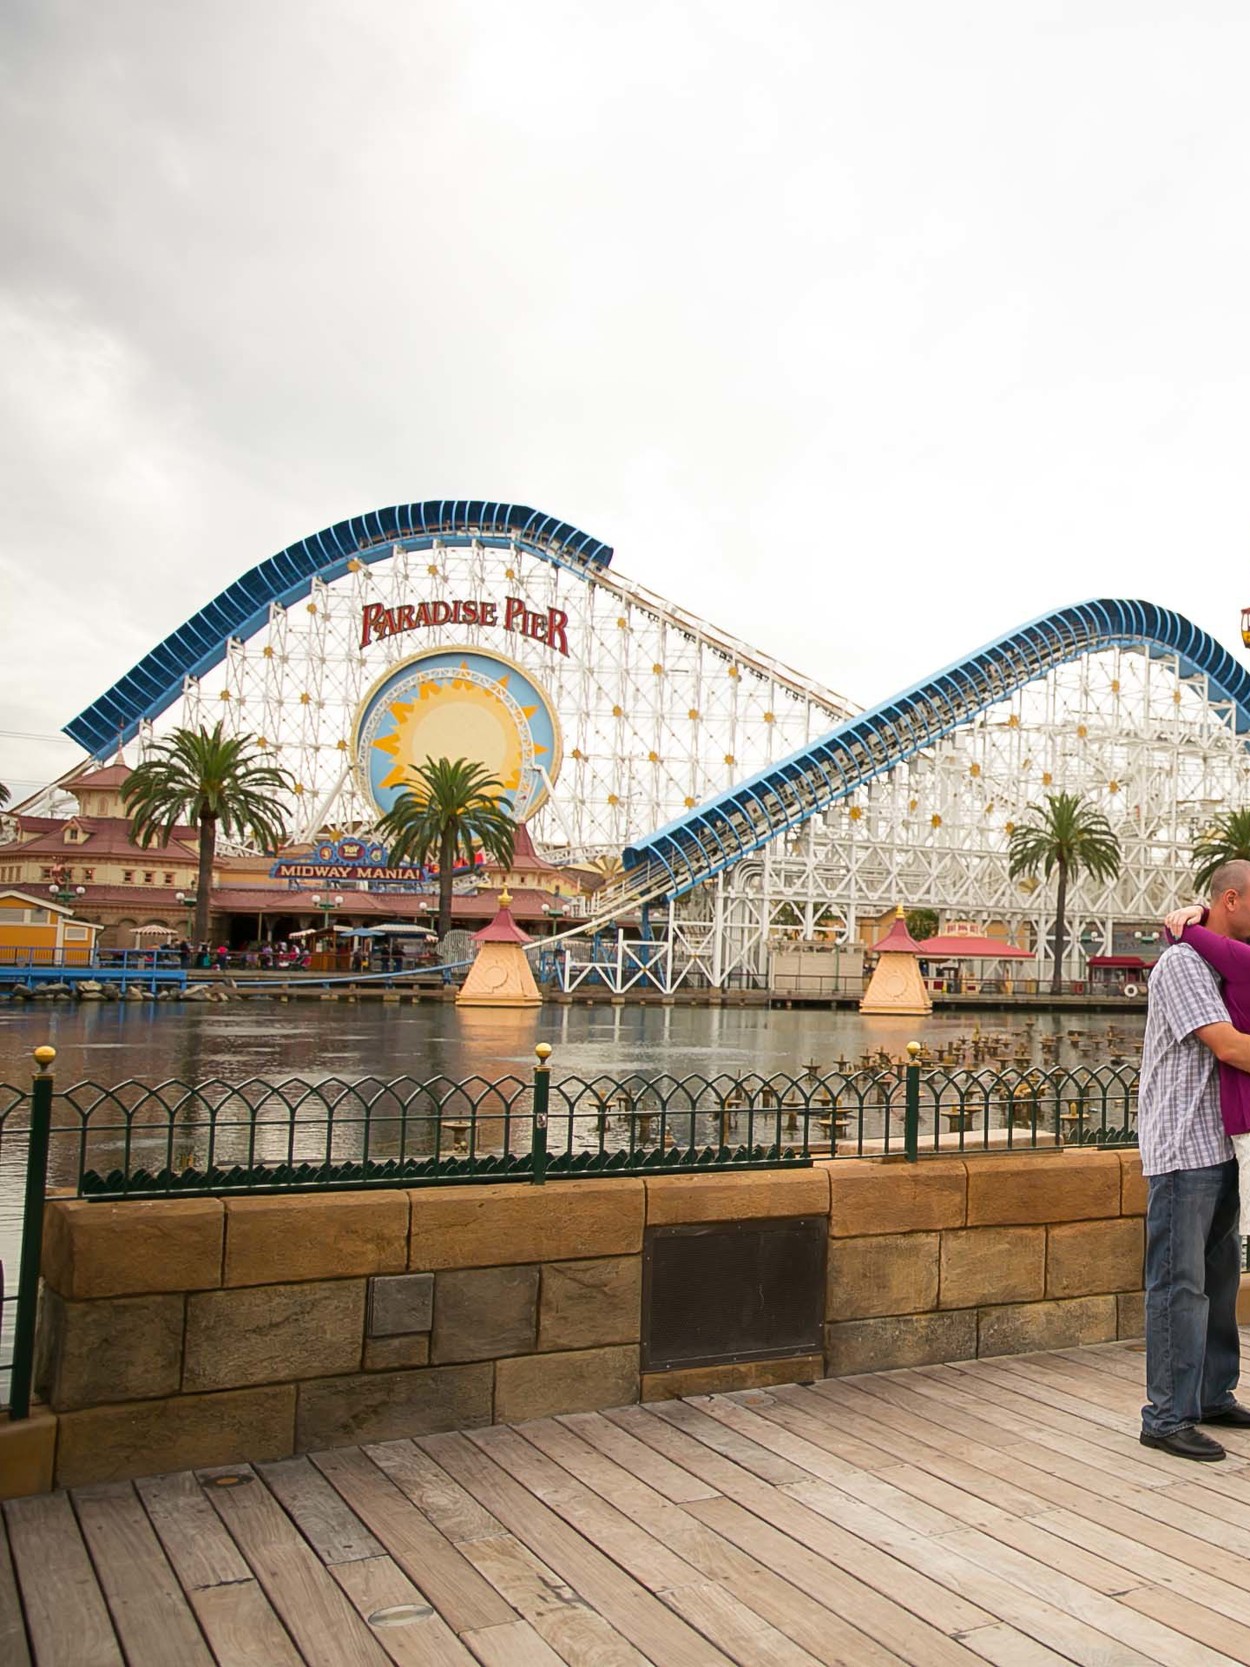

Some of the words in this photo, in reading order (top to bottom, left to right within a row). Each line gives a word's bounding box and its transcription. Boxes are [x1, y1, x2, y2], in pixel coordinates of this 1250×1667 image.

[360, 600, 498, 650] PARADISE
[503, 596, 570, 657] PIER
[280, 865, 352, 878] MIDWAY
[357, 867, 420, 880] MANIA!
